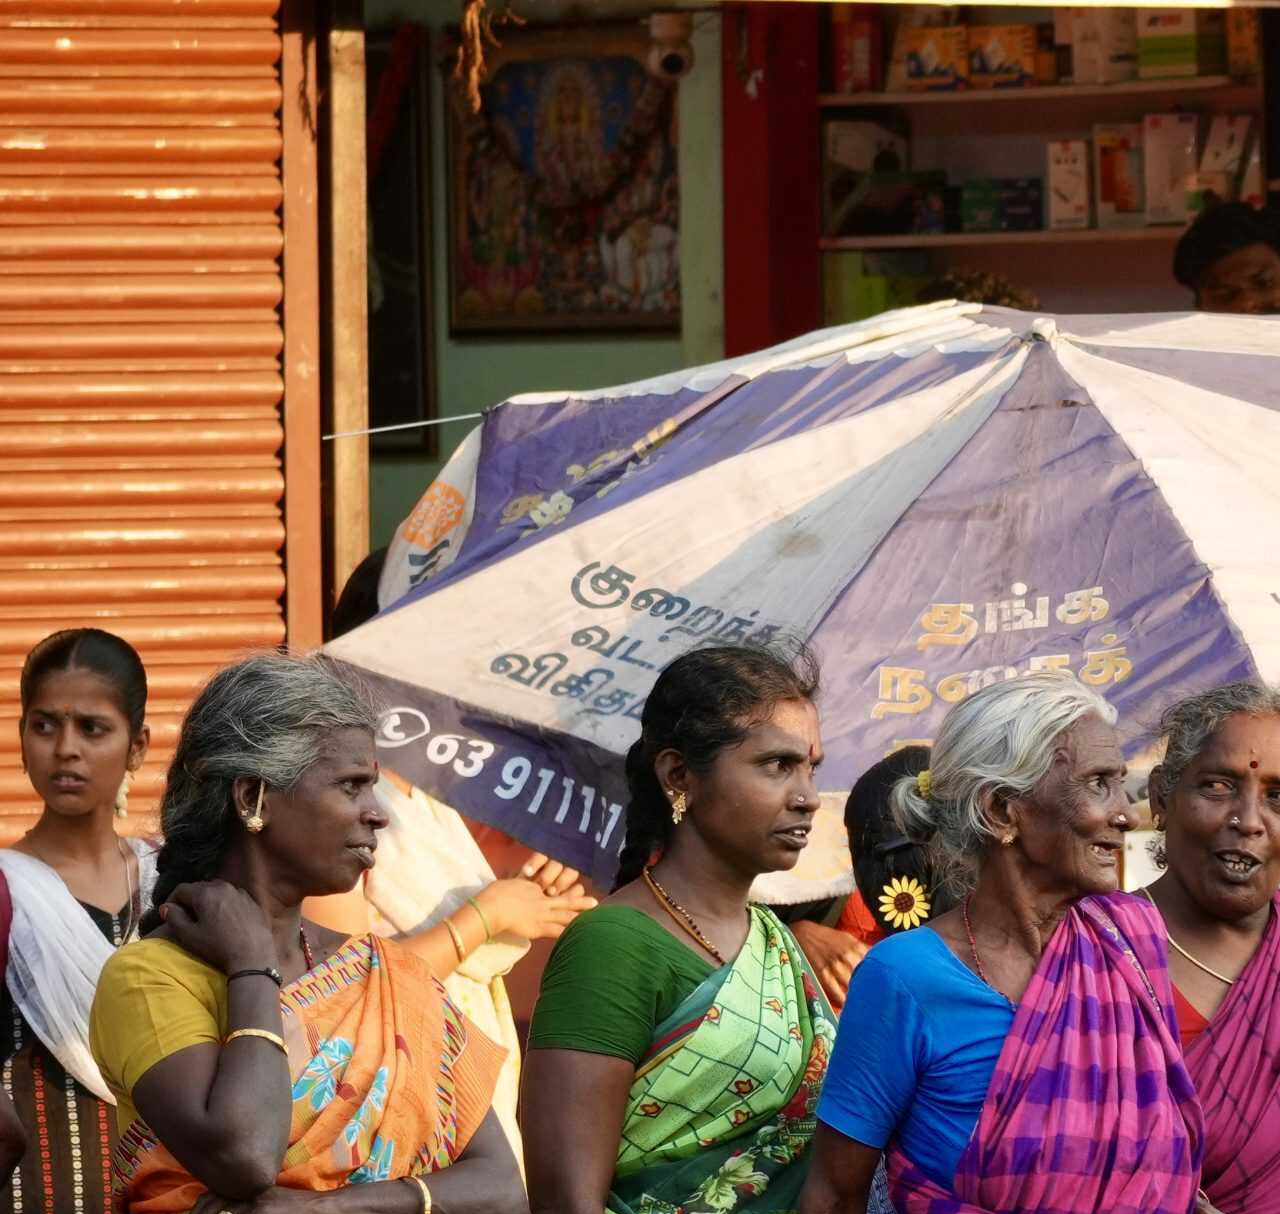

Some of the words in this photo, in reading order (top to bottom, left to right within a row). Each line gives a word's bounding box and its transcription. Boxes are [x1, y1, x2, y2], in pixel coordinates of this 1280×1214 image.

[917, 582, 1110, 651] தங்க
[490, 652, 643, 719] விகித
[426, 734, 495, 778] 63
